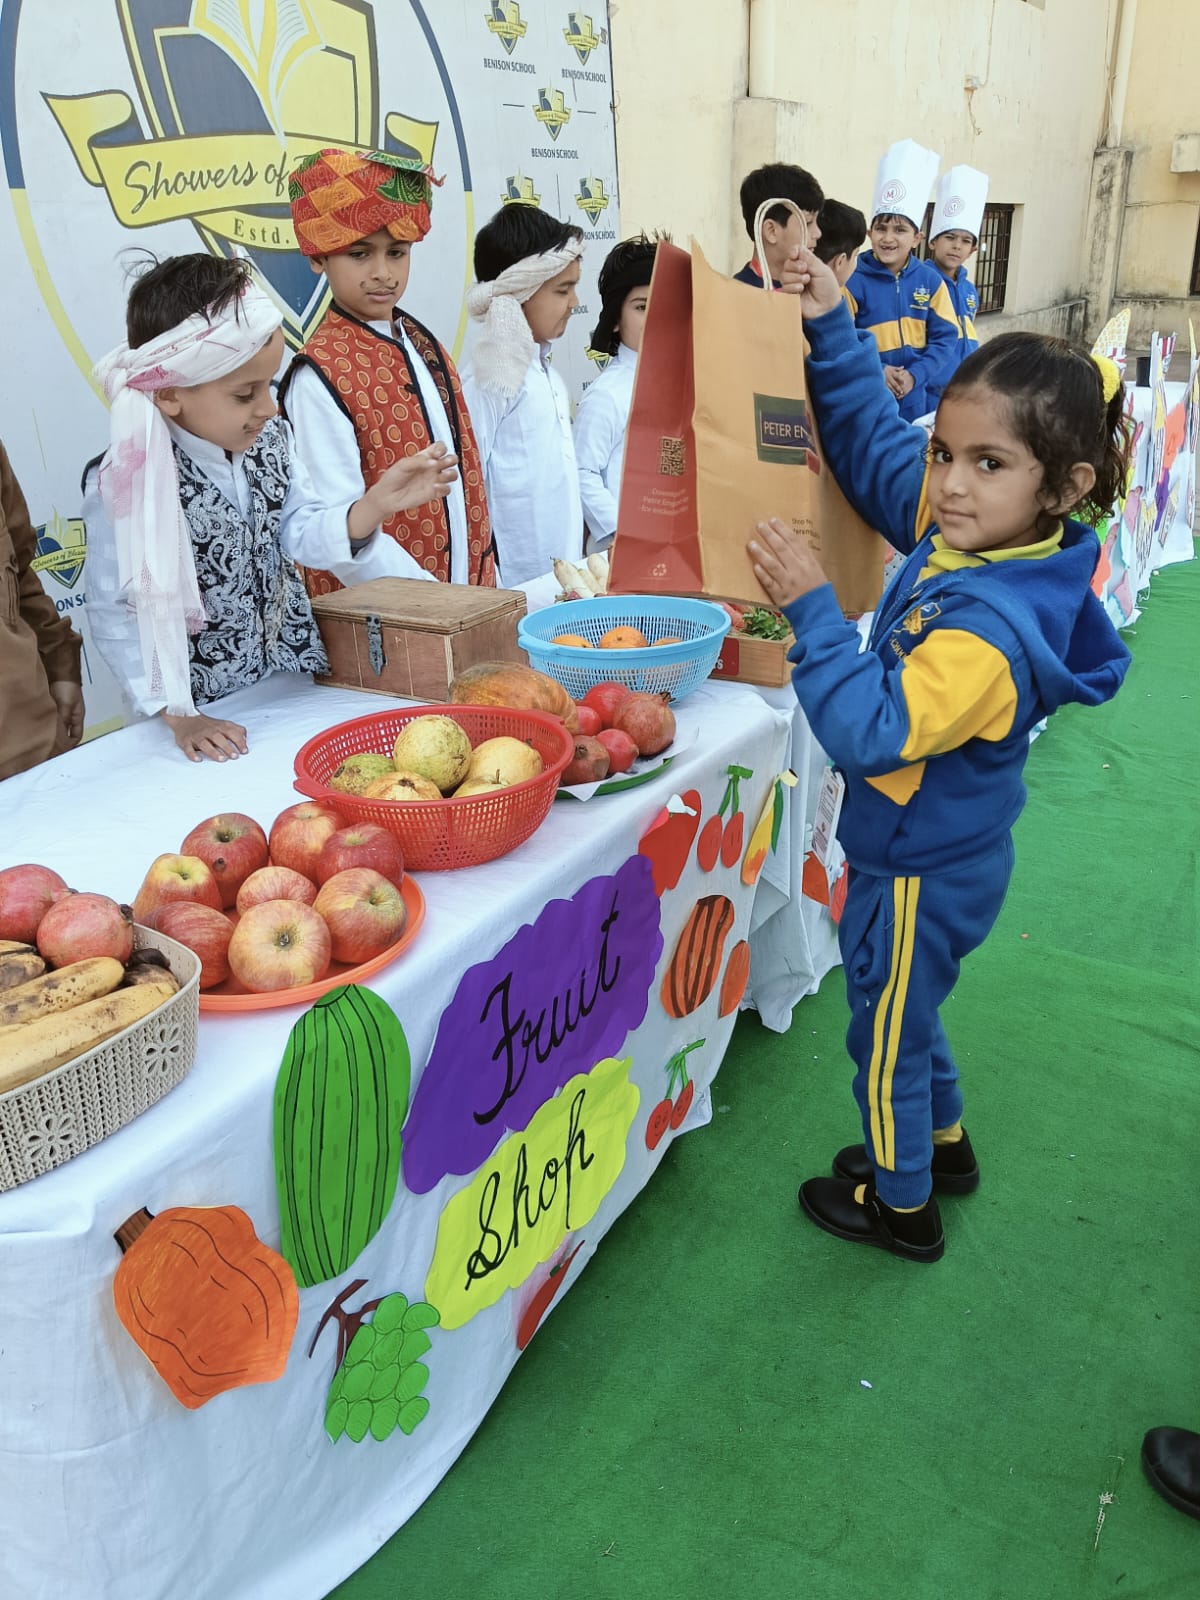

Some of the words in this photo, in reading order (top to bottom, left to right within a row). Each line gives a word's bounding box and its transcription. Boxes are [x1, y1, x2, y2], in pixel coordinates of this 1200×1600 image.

[483, 58, 511, 71] BENISON
[511, 63, 536, 74] SCHOOL
[562, 68, 585, 80] BENISON
[585, 71, 607, 83] SCHOOL
[531, 148, 556, 158] BENISON
[556, 149, 579, 159] SCHOOL
[124, 160, 258, 215] Showers
[264, 151, 290, 197] of
[233, 218, 291, 245] Estd.
[594, 231, 616, 241] SCHOOL
[571, 304, 588, 315] CHOOL
[763, 420, 792, 438] PETER
[473, 889, 621, 1126] Fruit
[464, 1087, 595, 1291] Shop
